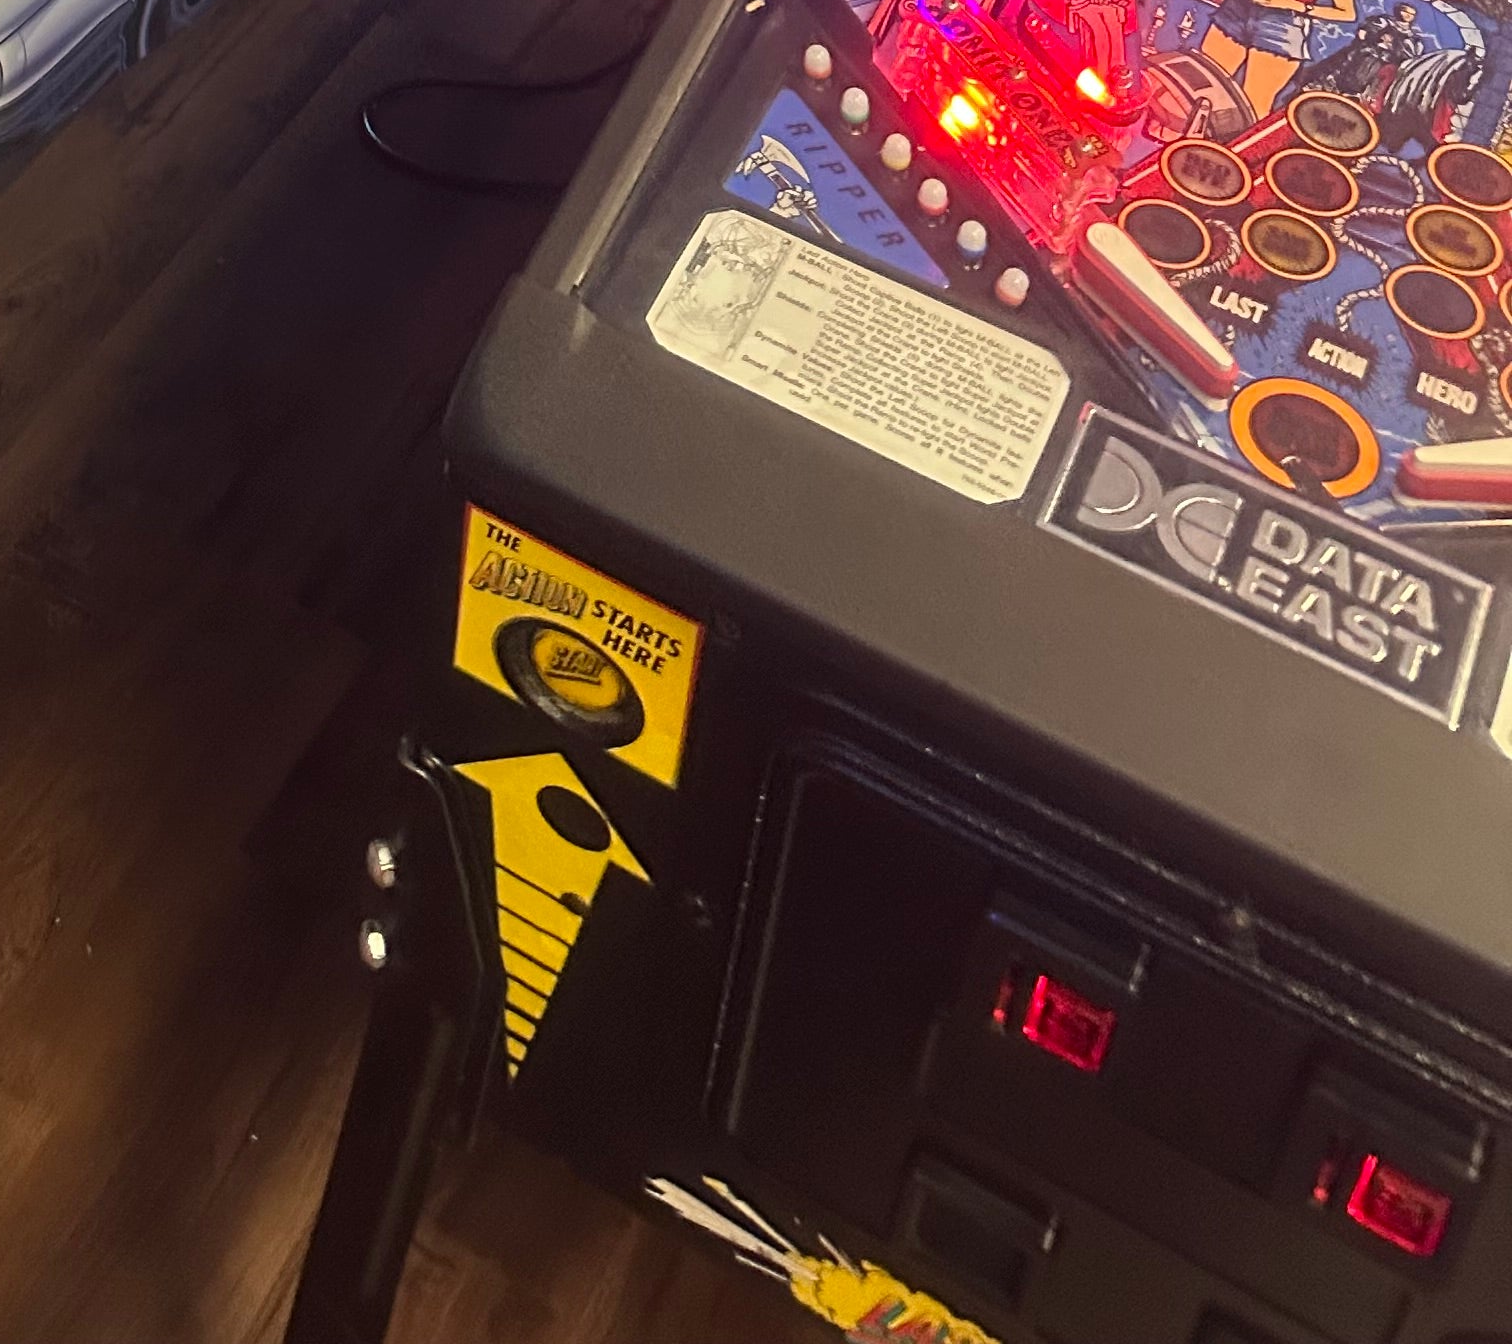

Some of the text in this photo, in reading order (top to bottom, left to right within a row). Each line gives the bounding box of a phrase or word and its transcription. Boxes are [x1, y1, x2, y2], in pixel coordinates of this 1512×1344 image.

[786, 118, 912, 249] RIPPER
[1210, 285, 1268, 325] LAST
[1308, 336, 1370, 379] ACTION
[1418, 372, 1478, 414] HERO
[483, 522, 521, 554] THE
[1252, 508, 1439, 632] DATA
[469, 550, 684, 659] ACTION STARTS
[1236, 555, 1442, 683] EAST
[602, 629, 667, 676] HERE
